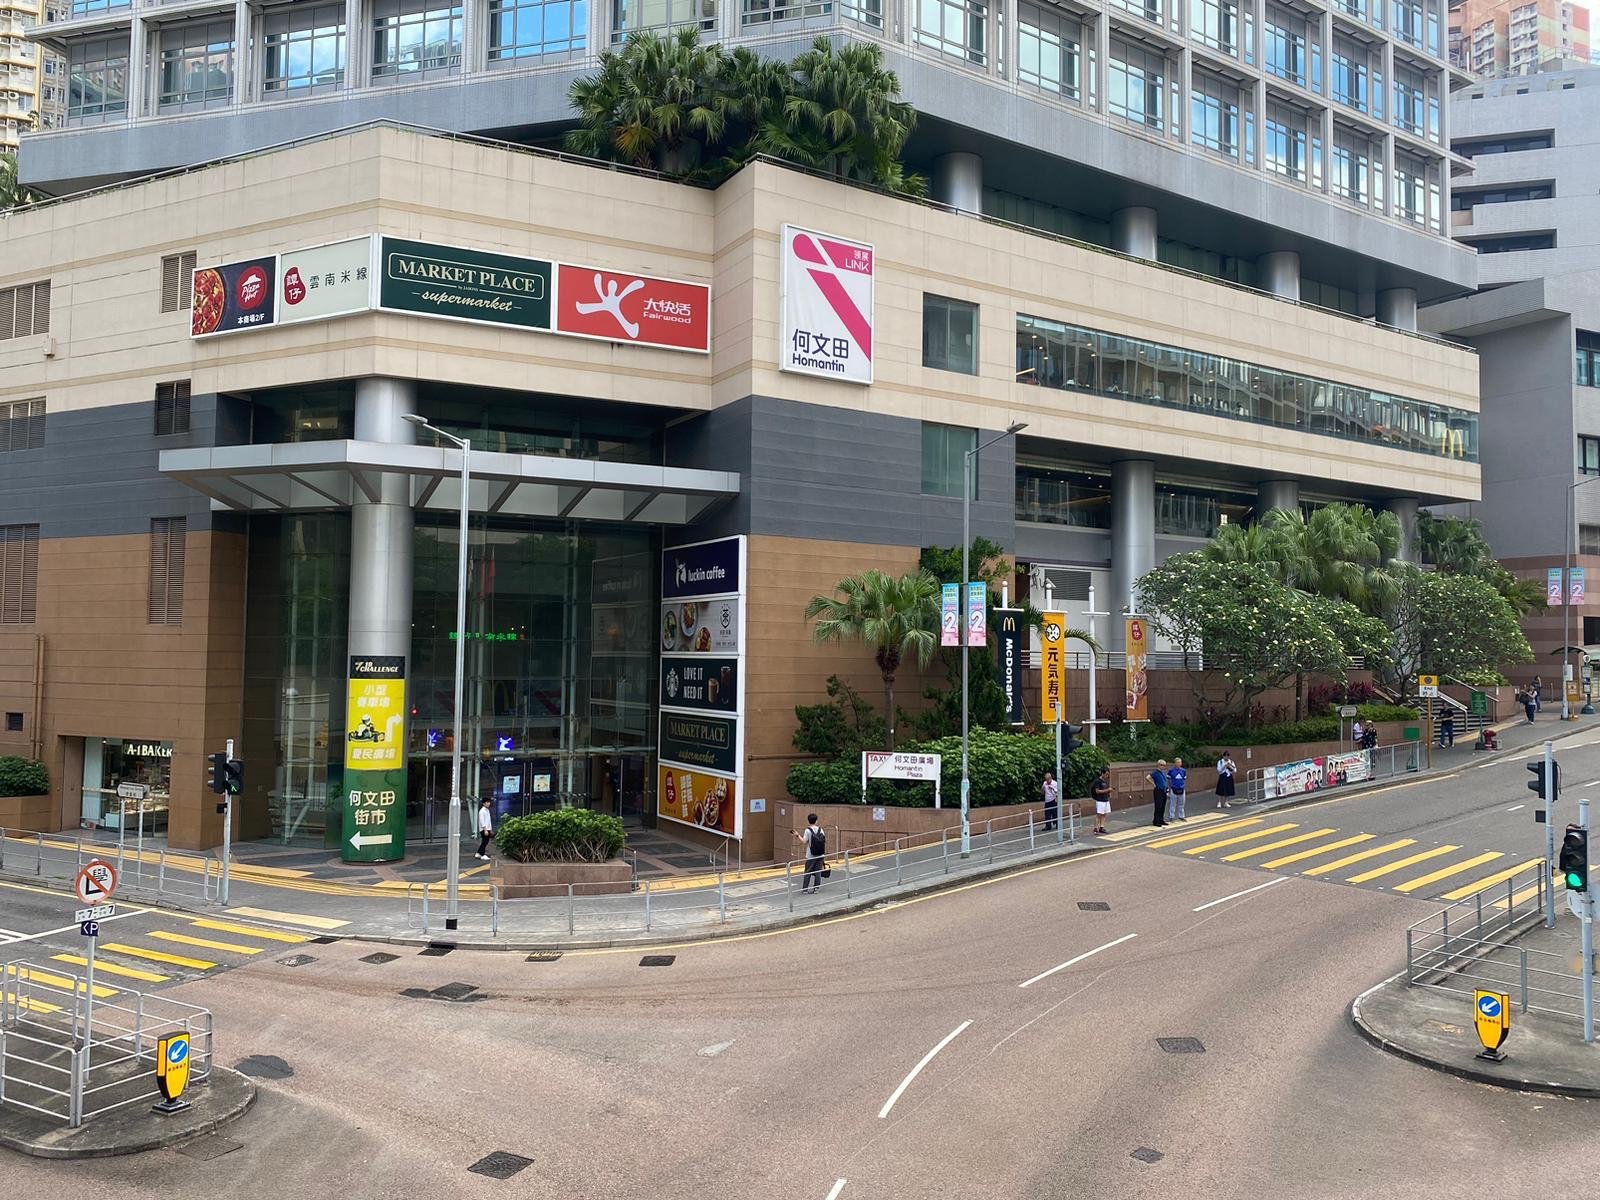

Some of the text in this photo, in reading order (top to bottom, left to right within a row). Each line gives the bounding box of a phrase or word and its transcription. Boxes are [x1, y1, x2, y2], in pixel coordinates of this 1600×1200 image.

[845, 259, 870, 272] LINK
[309, 267, 368, 290] 雲南米線
[398, 259, 536, 293] MARKET PLACE
[241, 283, 260, 297] Pizza
[286, 273, 303, 300] 譚仔
[244, 290, 257, 303] Hut
[422, 290, 513, 312] supermarket
[643, 298, 691, 316] 大快活
[643, 311, 692, 324] Fairwood
[792, 328, 849, 359] 何文田
[792, 352, 845, 373] Homantin
[687, 566, 725, 582] luckin coffee
[944, 611, 957, 633] 2
[971, 610, 984, 633] 2
[683, 667, 703, 681] LOVE IT
[683, 686, 703, 700] NEED IT
[670, 721, 726, 743] MARKET PLACE
[678, 749, 715, 764] supermarket
[895, 755, 934, 765] 何文田廣場
[348, 790, 395, 807] 何文田
[354, 809, 387, 826] 街市
[108, 905, 114, 914] 7
[90, 922, 99, 934] P
